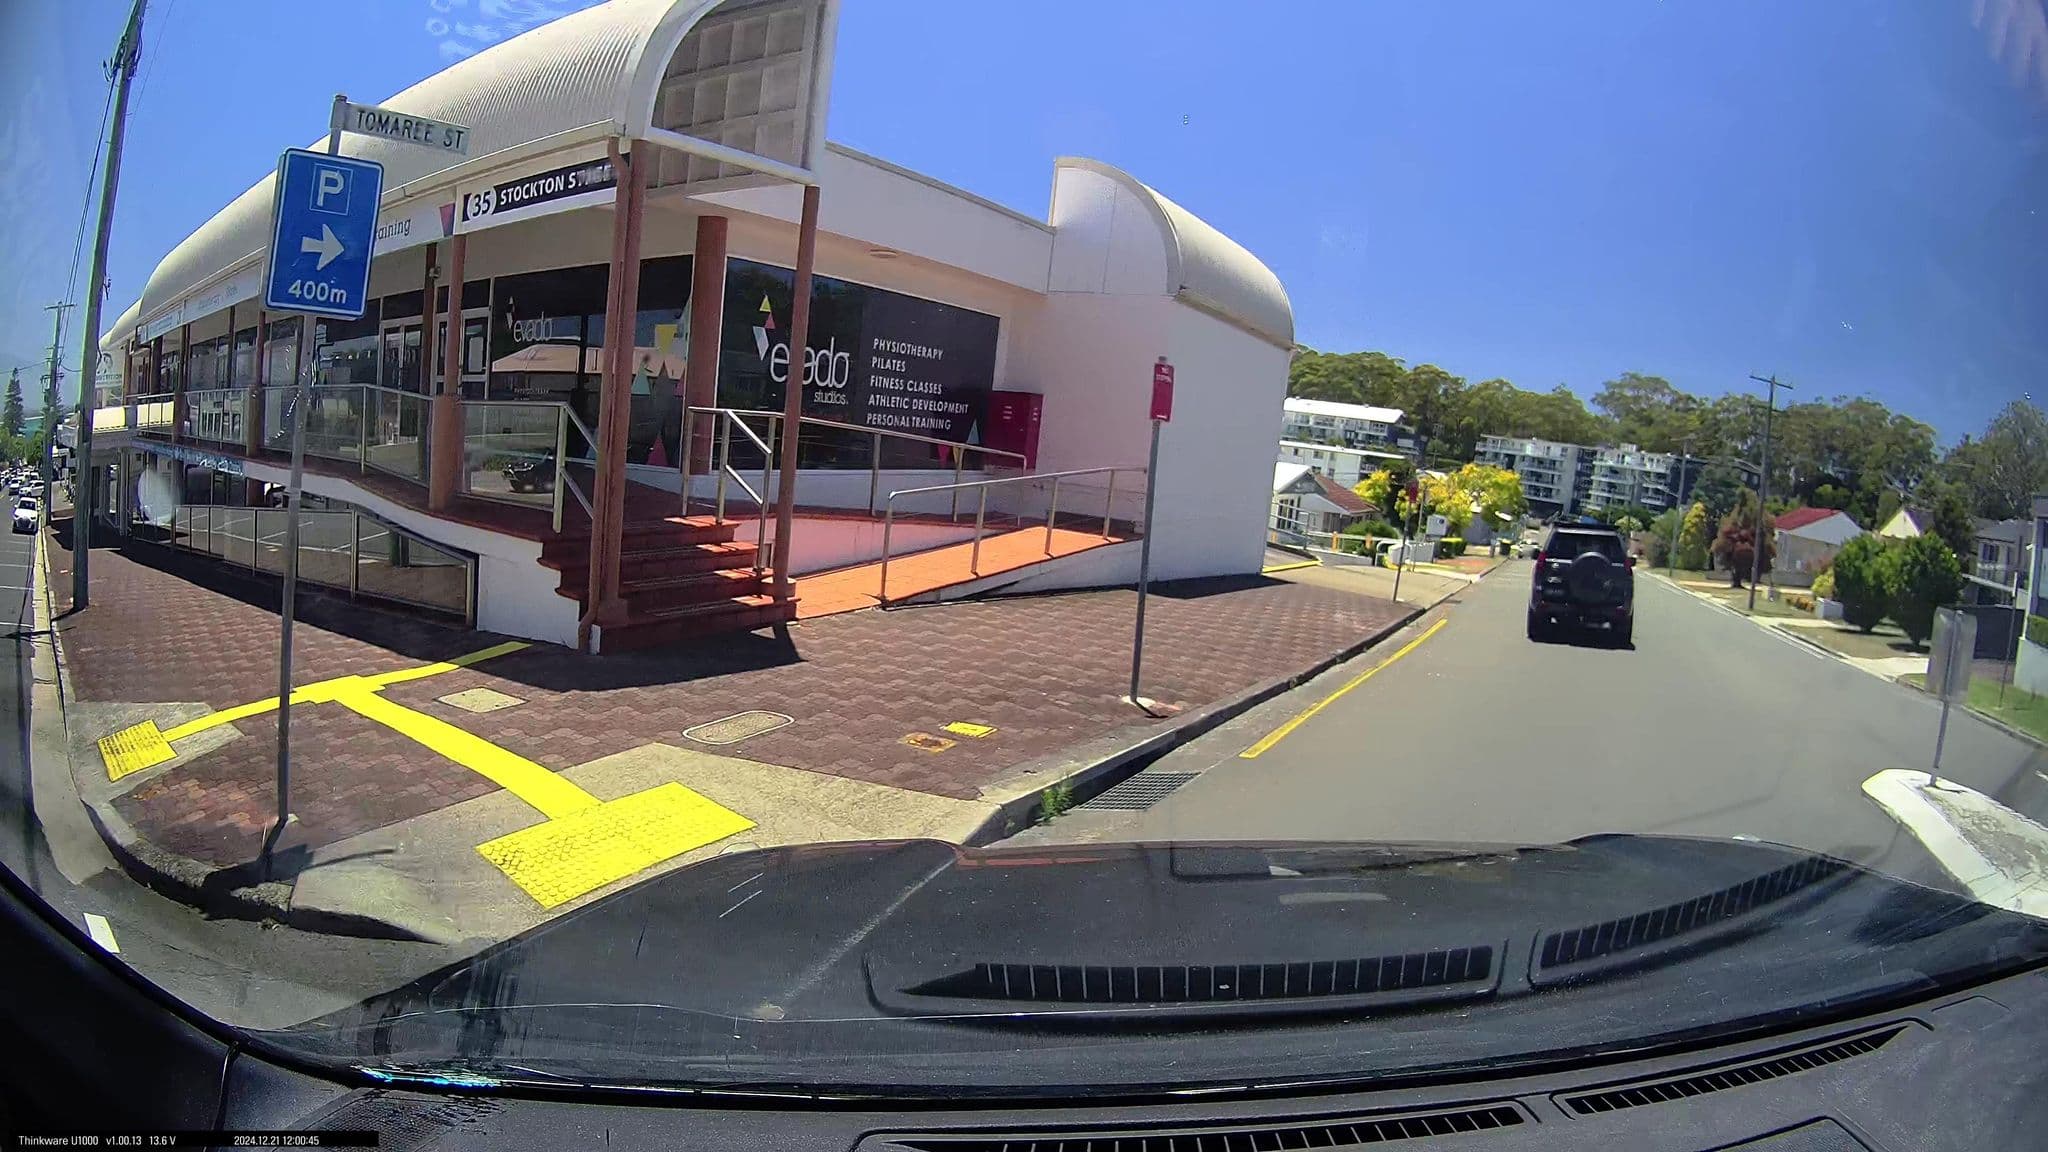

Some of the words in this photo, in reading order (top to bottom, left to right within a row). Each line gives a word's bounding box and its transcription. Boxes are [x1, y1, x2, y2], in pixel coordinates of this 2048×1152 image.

[358, 109, 435, 144] TOMAREE
[443, 127, 465, 149] ST
[317, 169, 345, 207] P
[500, 174, 566, 206] STOCKTON
[376, 218, 412, 239] aining
[288, 279, 347, 304] 400m
[873, 338, 944, 360] PHYSIOTHERAPY
[770, 336, 850, 389] eado
[871, 356, 906, 372] PILATES
[870, 375, 904, 390] FITNESS
[906, 380, 943, 395] CLASSES
[868, 394, 909, 409] ATHLETIC
[912, 398, 969, 414] DEVELOPMENT
[866, 413, 909, 427] PERSONAL
[911, 416, 952, 430] TRAINING
